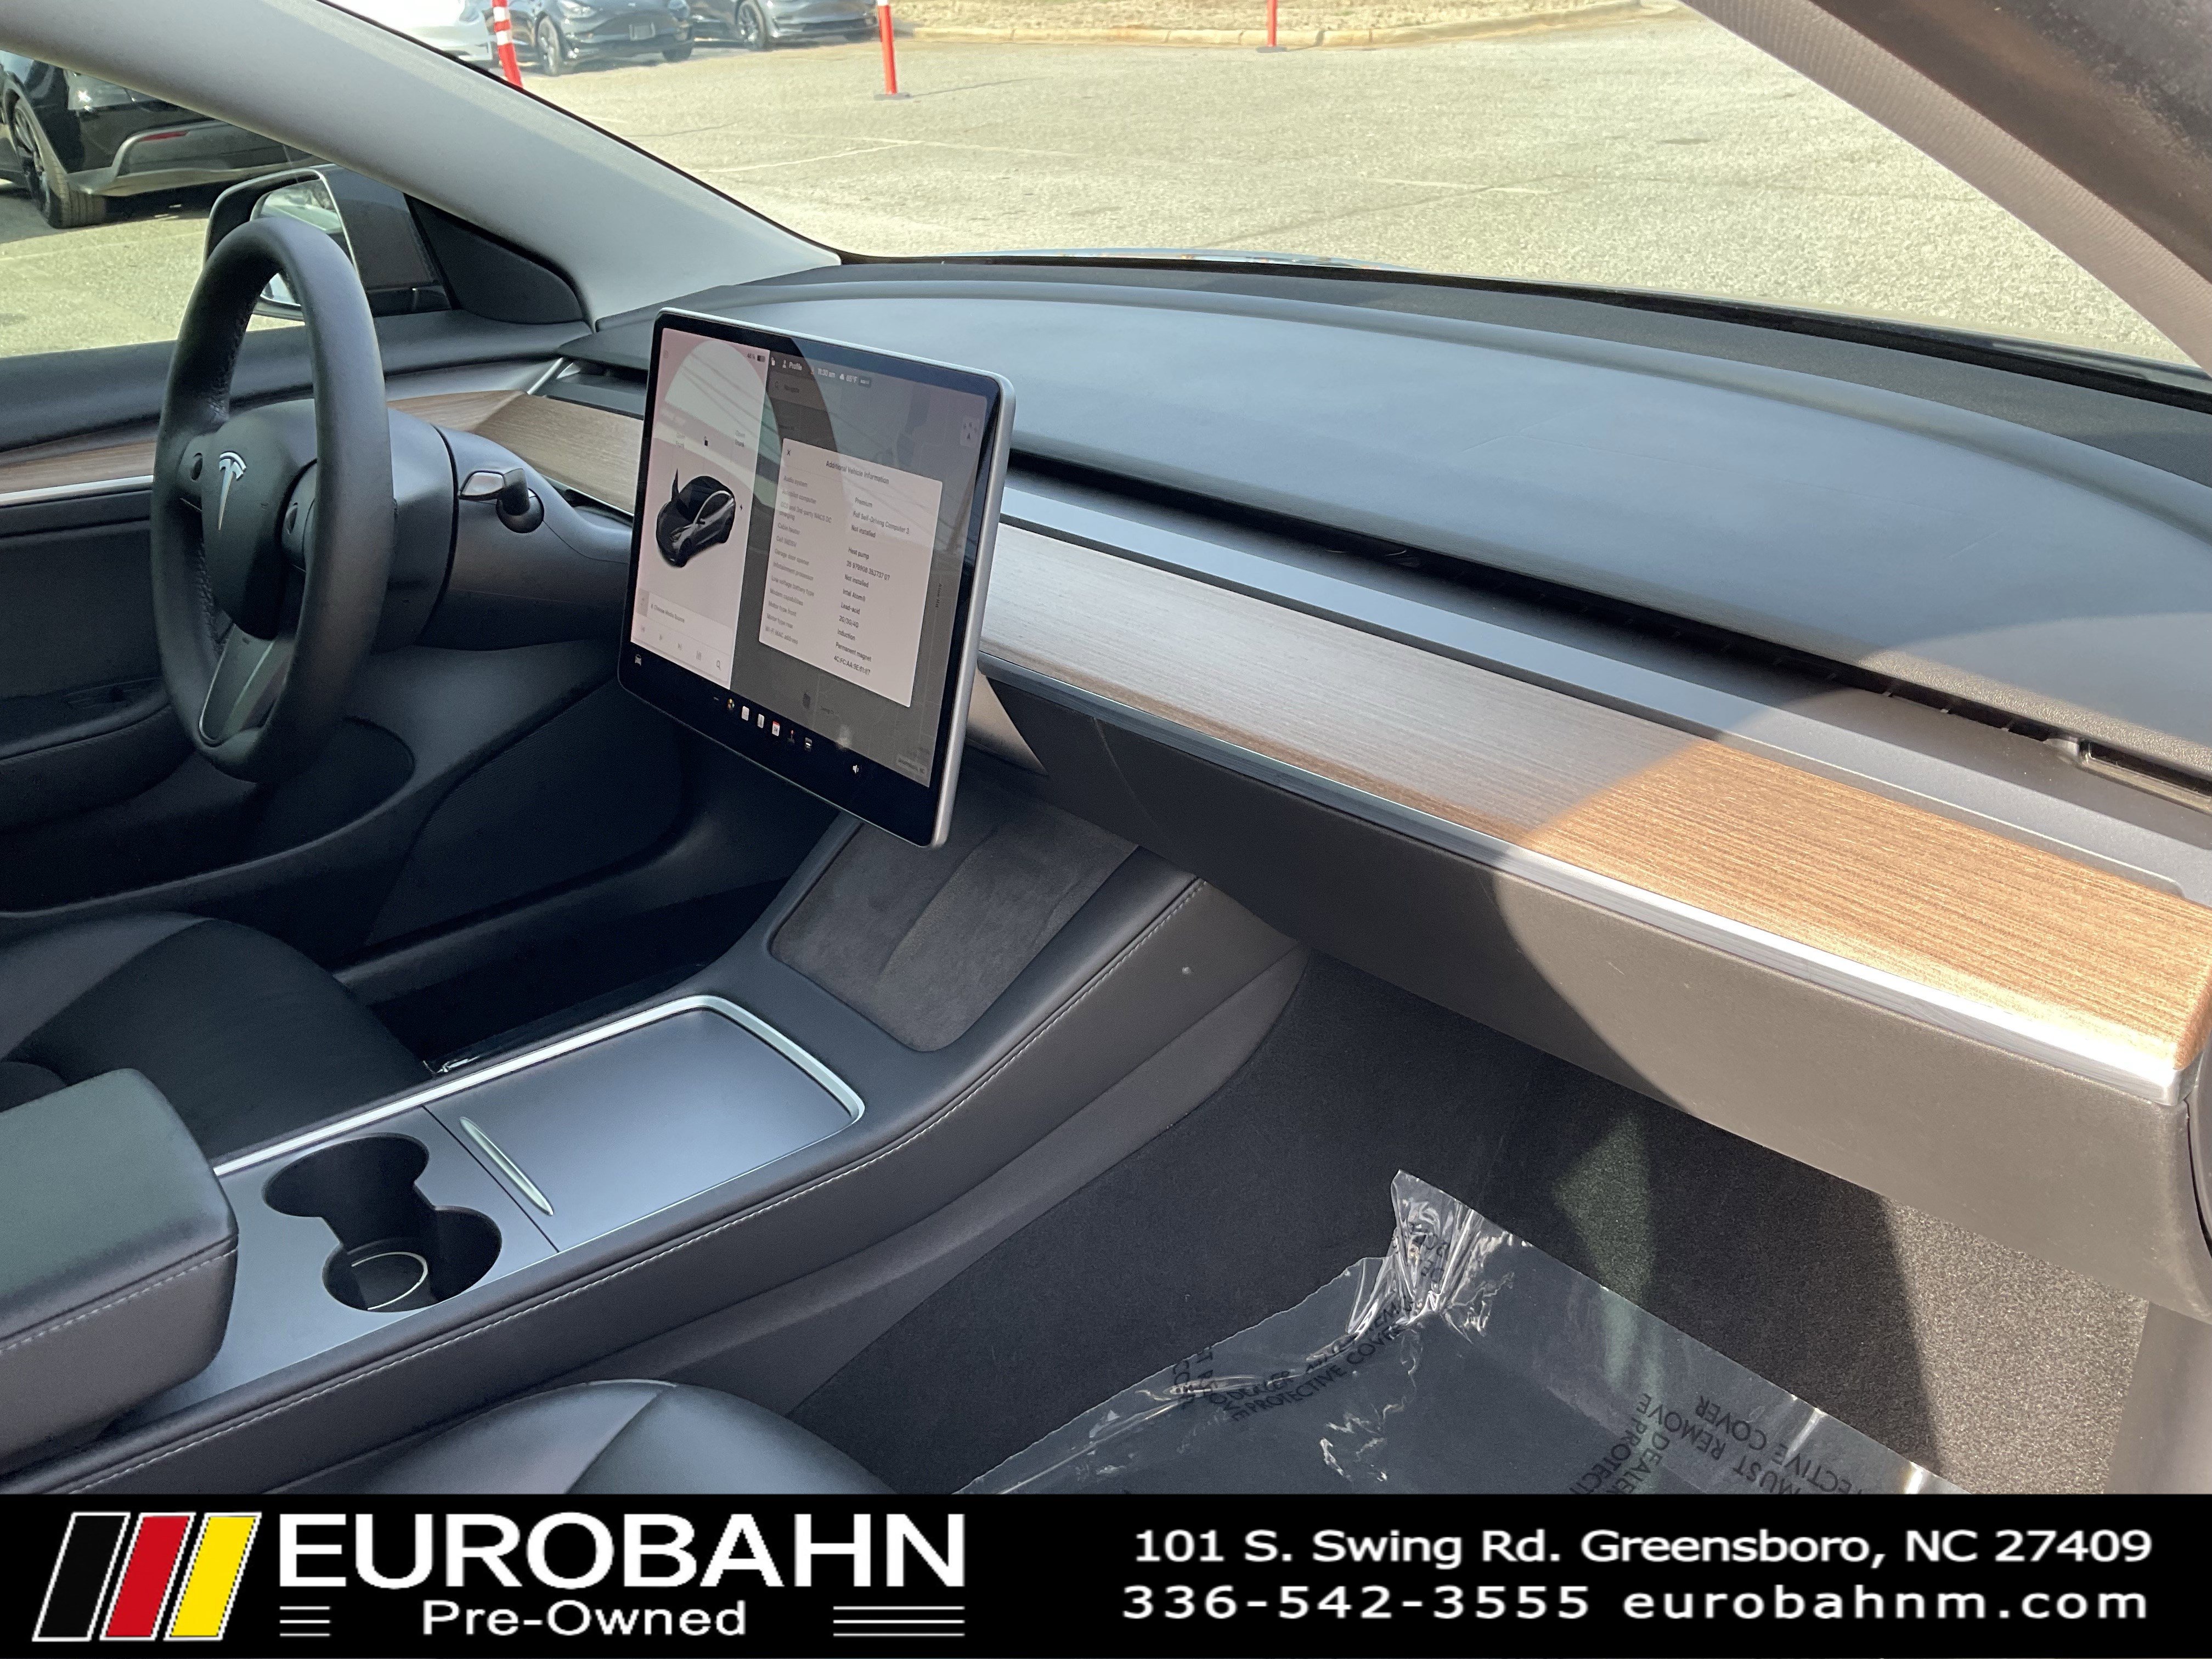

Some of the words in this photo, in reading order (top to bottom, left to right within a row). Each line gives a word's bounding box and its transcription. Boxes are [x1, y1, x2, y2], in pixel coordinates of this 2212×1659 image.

[826, 460, 847, 472] Additional
[848, 466, 864, 477] Vehicle
[864, 471, 889, 484] Information
[783, 475, 794, 483] Audio
[794, 479, 808, 488] system
[798, 495, 817, 504] computer
[855, 496, 873, 508] Premium
[861, 514, 884, 527] Self-Driving
[885, 521, 906, 533] Computer
[859, 528, 876, 538] installed
[848, 546, 857, 556] Heat
[857, 551, 870, 560] pump
[852, 578, 869, 588] installed
[840, 601, 861, 615] Lead-acid
[837, 628, 856, 641] Induction
[836, 641, 856, 656] Permanent
[856, 651, 872, 662] magnet
[1244, 1364, 1346, 1414] PROTECTIVE
[1635, 1393, 1726, 1460] REMOVE
[1695, 1395, 1768, 1451] COVER
[1771, 1443, 1863, 1494] ECTIVE
